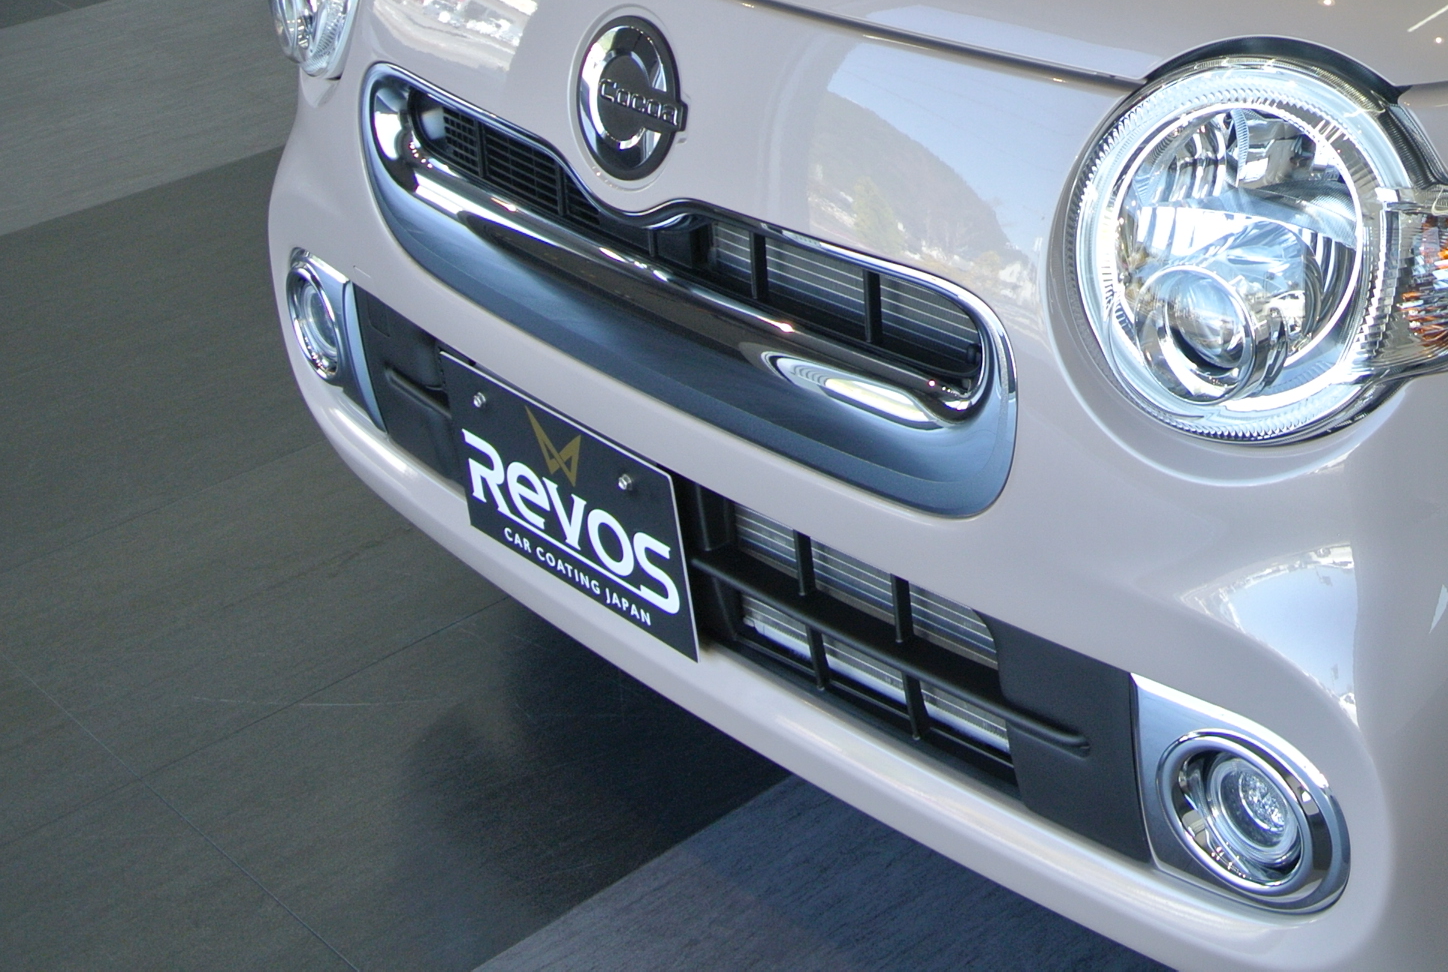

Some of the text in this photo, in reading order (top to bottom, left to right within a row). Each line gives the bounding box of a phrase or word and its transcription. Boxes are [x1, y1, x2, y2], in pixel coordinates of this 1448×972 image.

[504, 527, 651, 626] CAR COATING JAPAN
